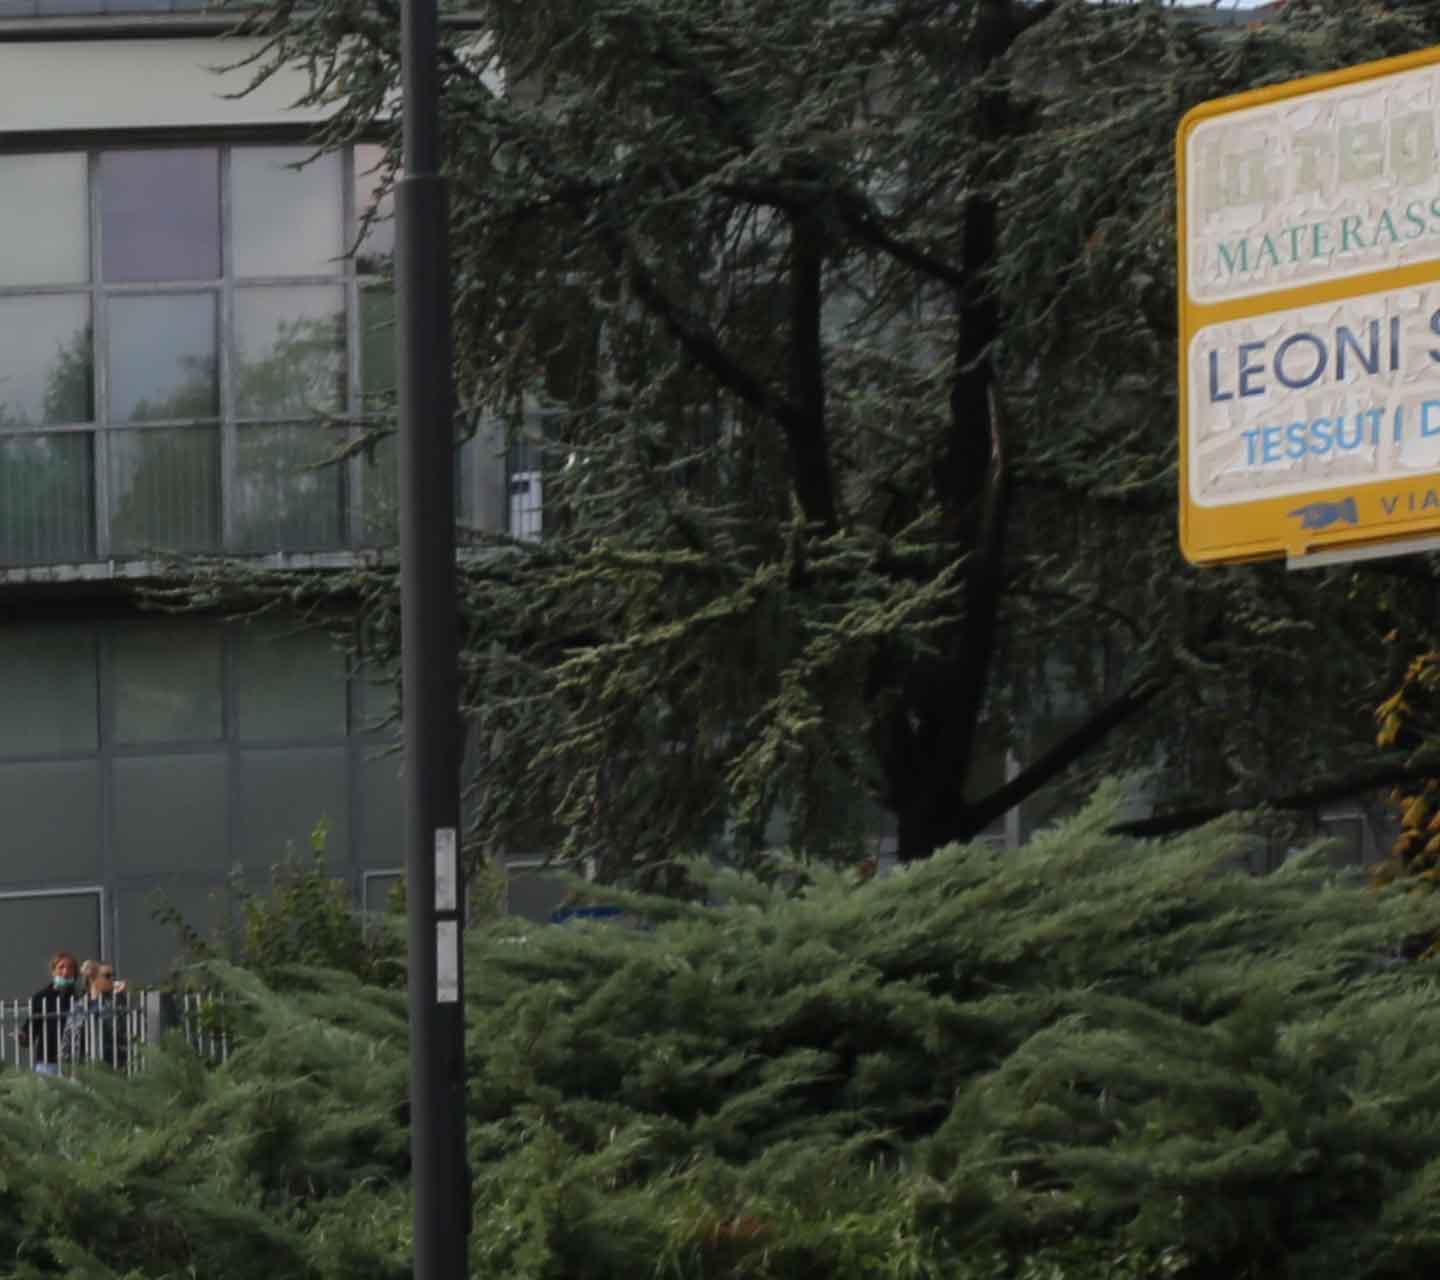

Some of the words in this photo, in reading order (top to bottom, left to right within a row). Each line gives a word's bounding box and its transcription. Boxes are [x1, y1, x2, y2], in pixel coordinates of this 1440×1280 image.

[1208, 316, 1400, 404] LEONI
[1240, 404, 1404, 466] TESSUTI
[1381, 488, 1440, 515] VIA
